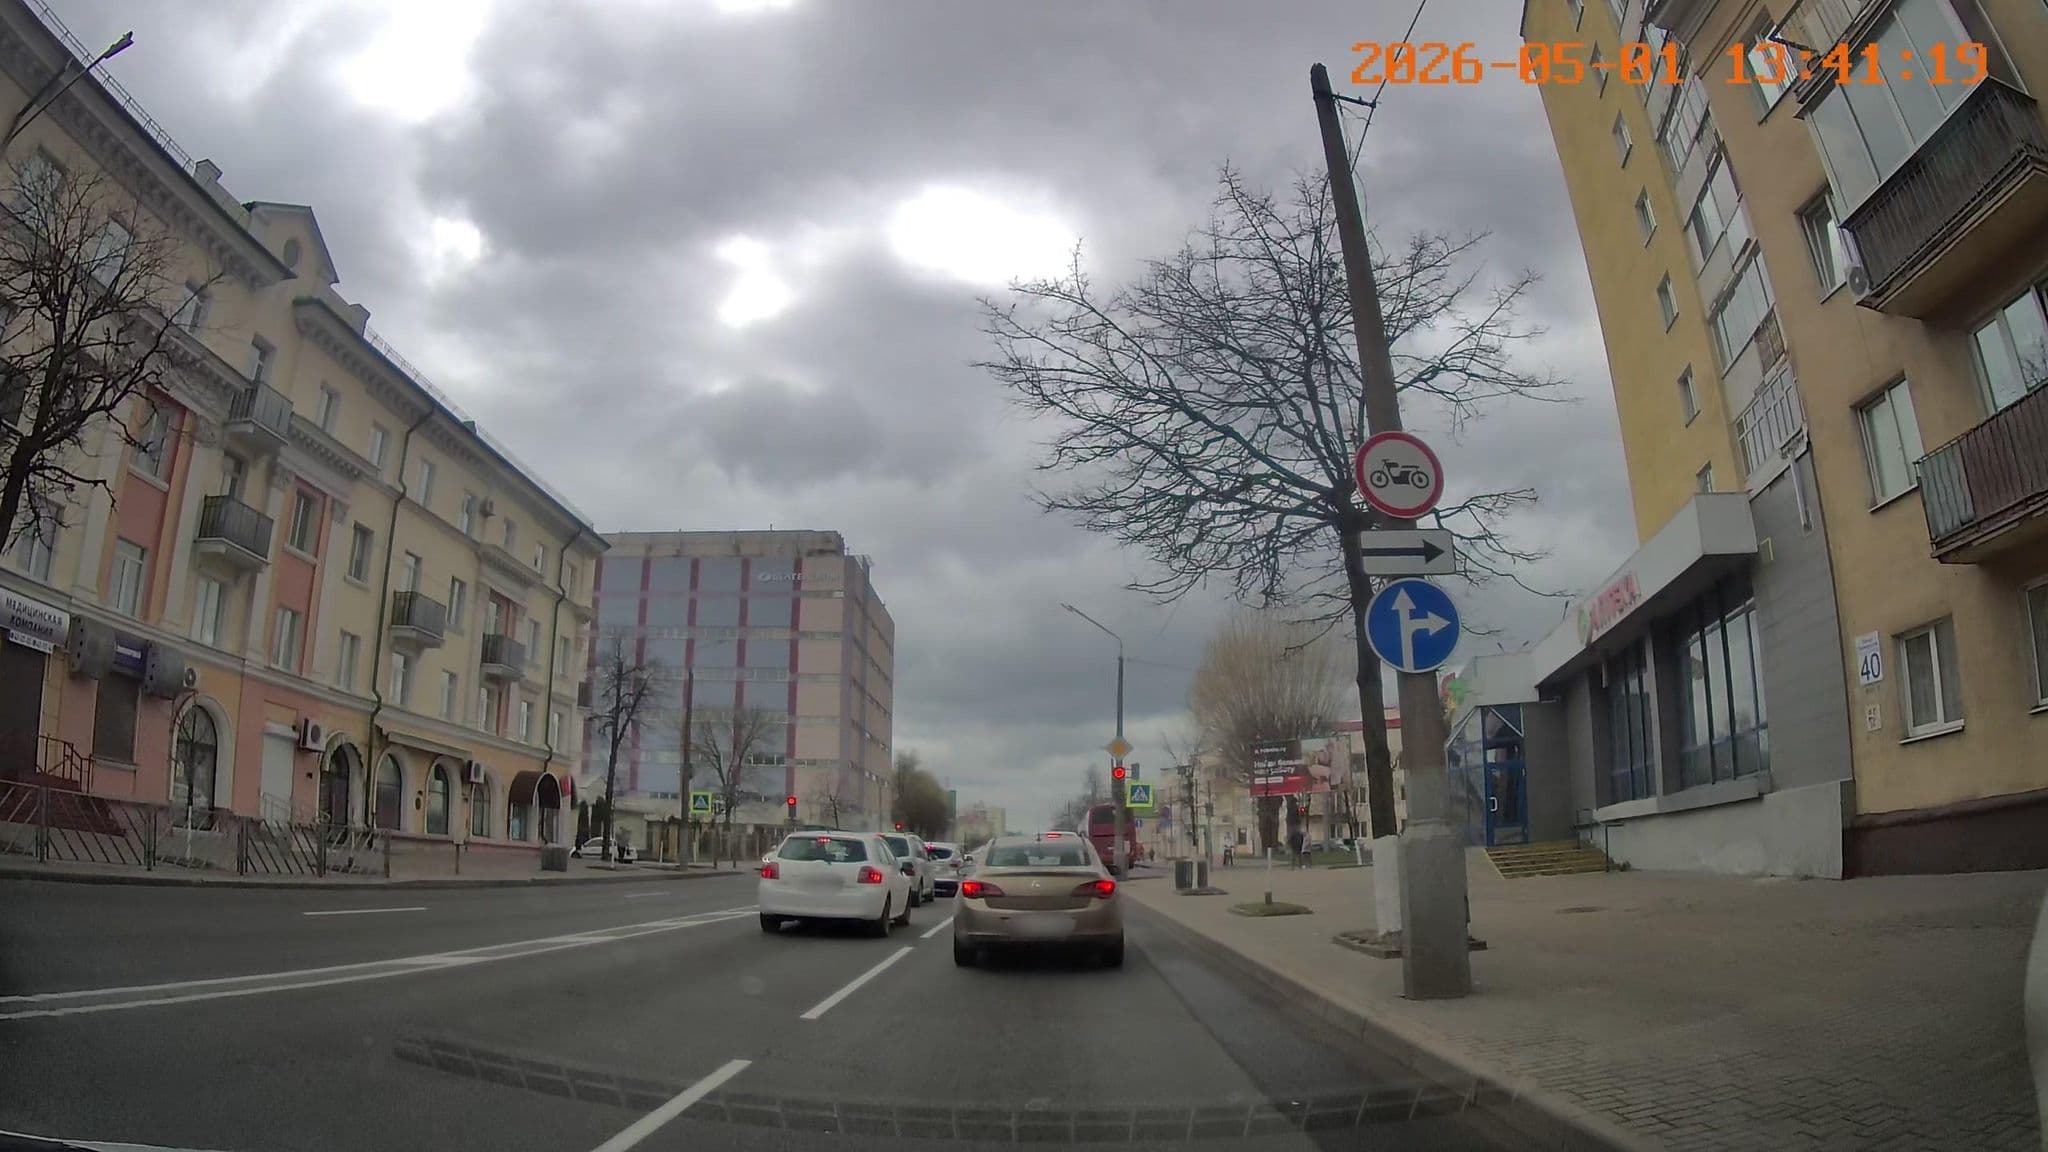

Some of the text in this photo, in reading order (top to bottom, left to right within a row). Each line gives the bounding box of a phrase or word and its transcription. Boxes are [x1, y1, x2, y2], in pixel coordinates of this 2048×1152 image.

[6, 597, 63, 626] МЕДИЦИНСКАЯ
[10, 615, 53, 637] КОМПАНИЯ
[1861, 653, 1881, 681] 40
